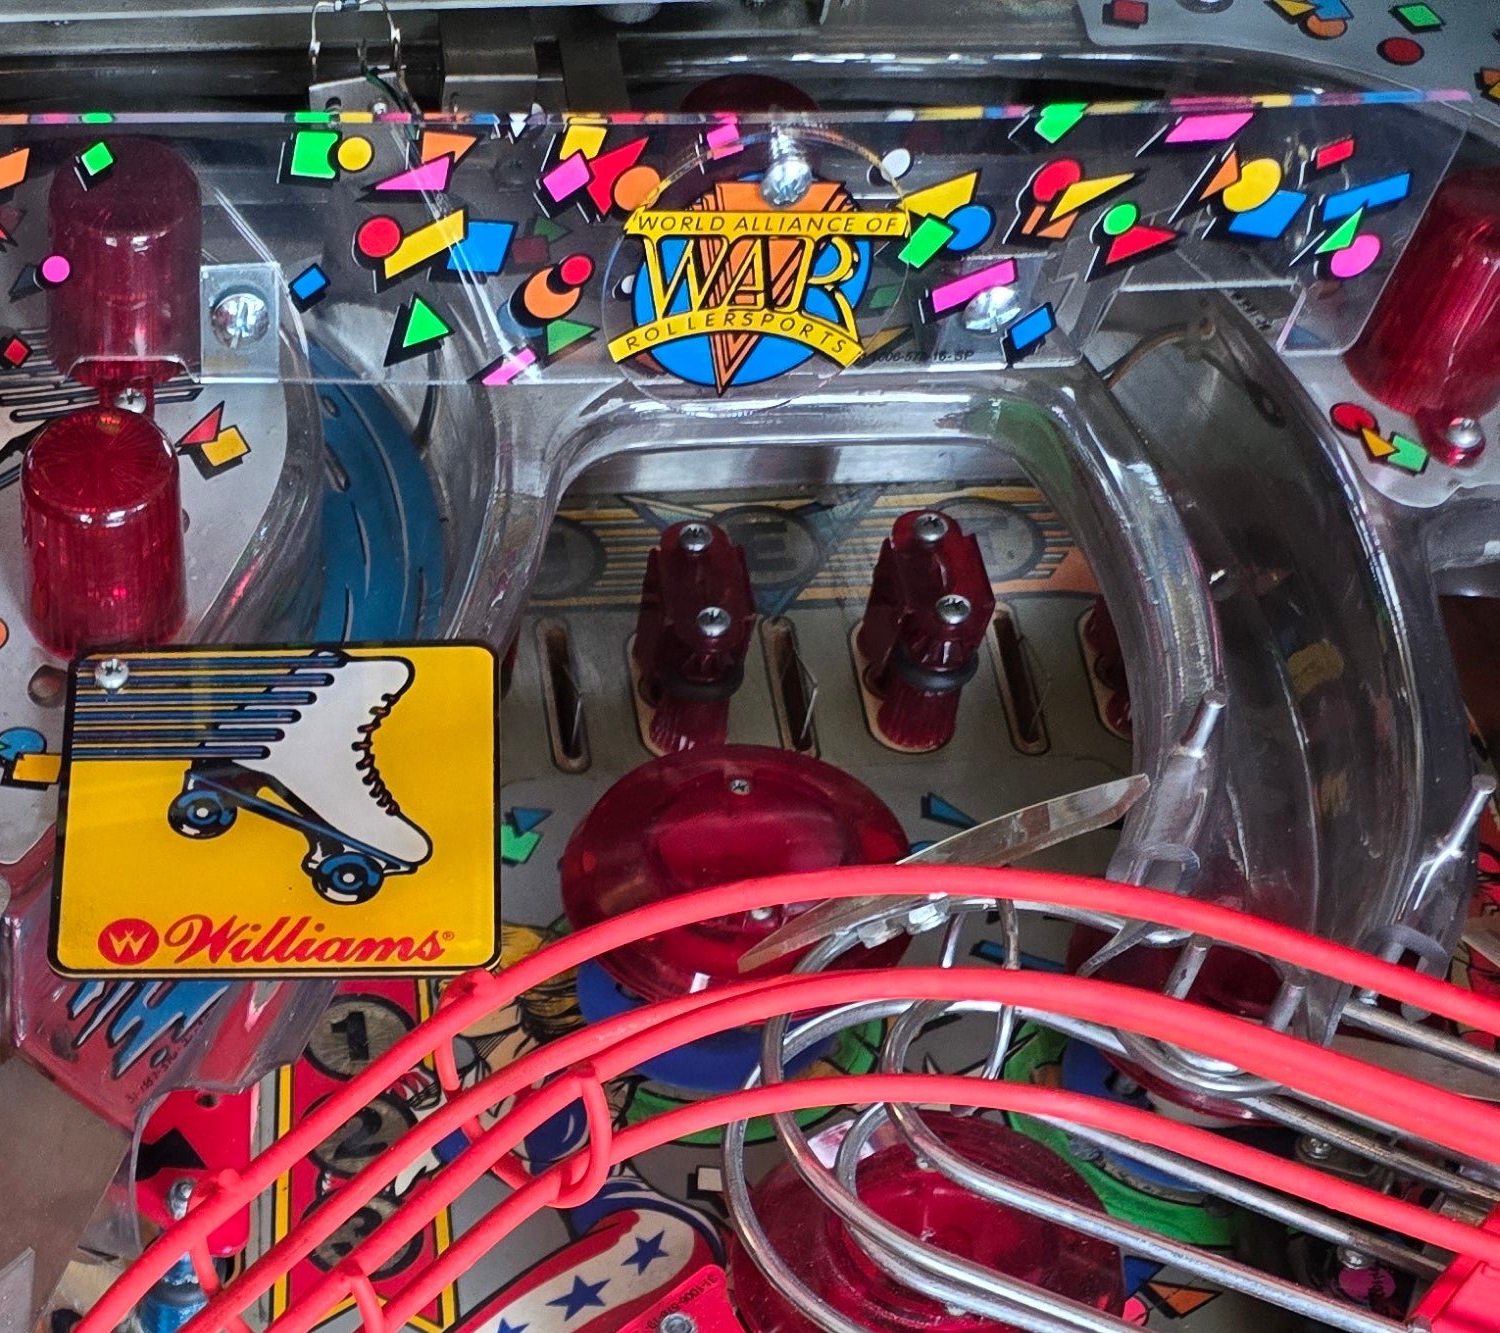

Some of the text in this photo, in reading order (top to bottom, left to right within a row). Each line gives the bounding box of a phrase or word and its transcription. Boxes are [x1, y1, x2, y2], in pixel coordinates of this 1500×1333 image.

[639, 215, 897, 232] WORLD ALLIANCE OF
[643, 234, 859, 340] WAR
[626, 311, 847, 354] ROLLERSPORTS
[331, 1010, 371, 1062] 1
[335, 1107, 390, 1160] 2
